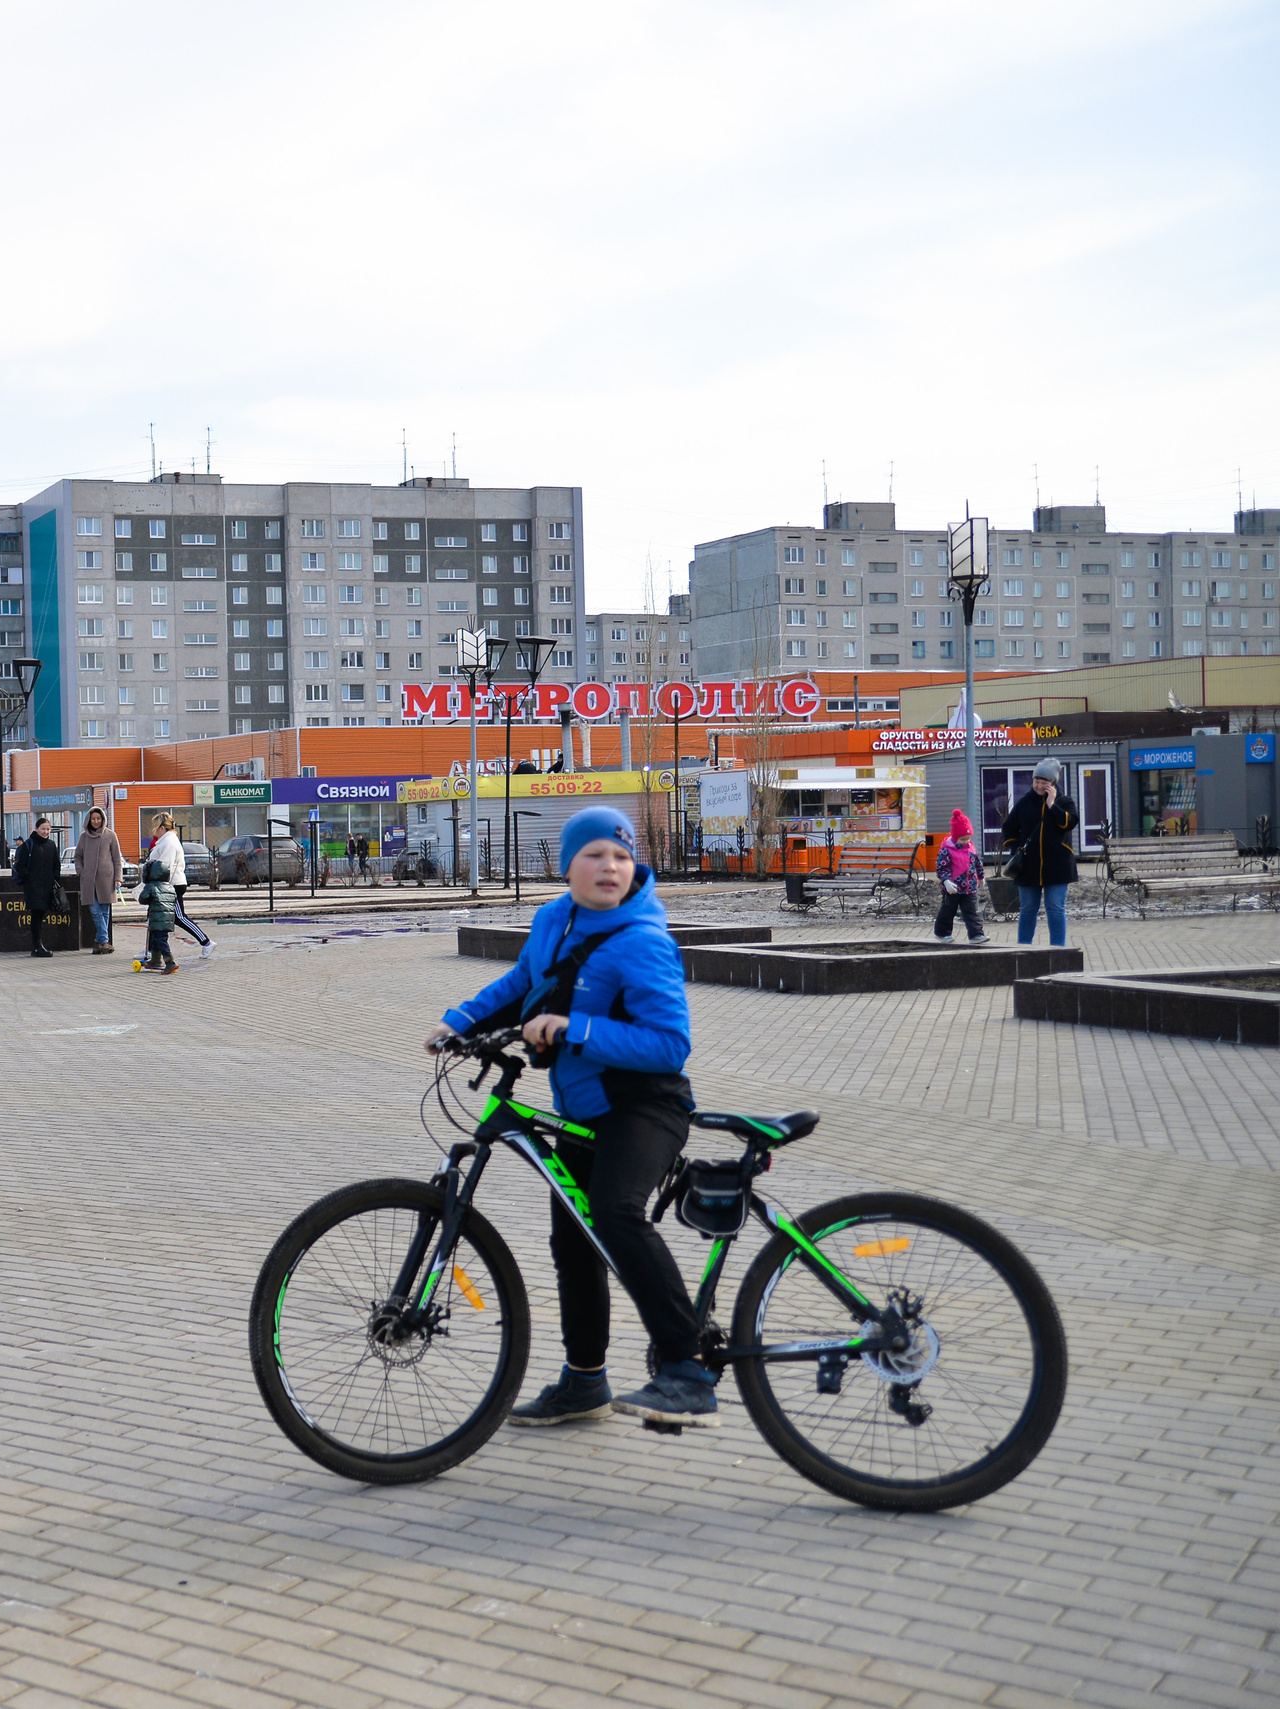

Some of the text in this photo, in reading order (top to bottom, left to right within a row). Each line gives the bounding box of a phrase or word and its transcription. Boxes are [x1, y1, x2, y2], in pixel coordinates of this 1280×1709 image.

[401, 679, 820, 720] МЕТРОПОЛИС
[879, 729, 1008, 741] ФРУКТЫ СУХОРУКТЫ
[872, 739, 1014, 751] СЛАДОСТИ ИЗ КАЗХСТАНА
[1144, 751, 1193, 764] МОРОЖЕНОЕ
[547, 774, 585, 782] доставка
[220, 787, 266, 796] БАНКОМАТ
[317, 782, 390, 798] Связной
[18, 915, 71, 927] (18-1994)
[799, 1341, 840, 1350] DRIVE
